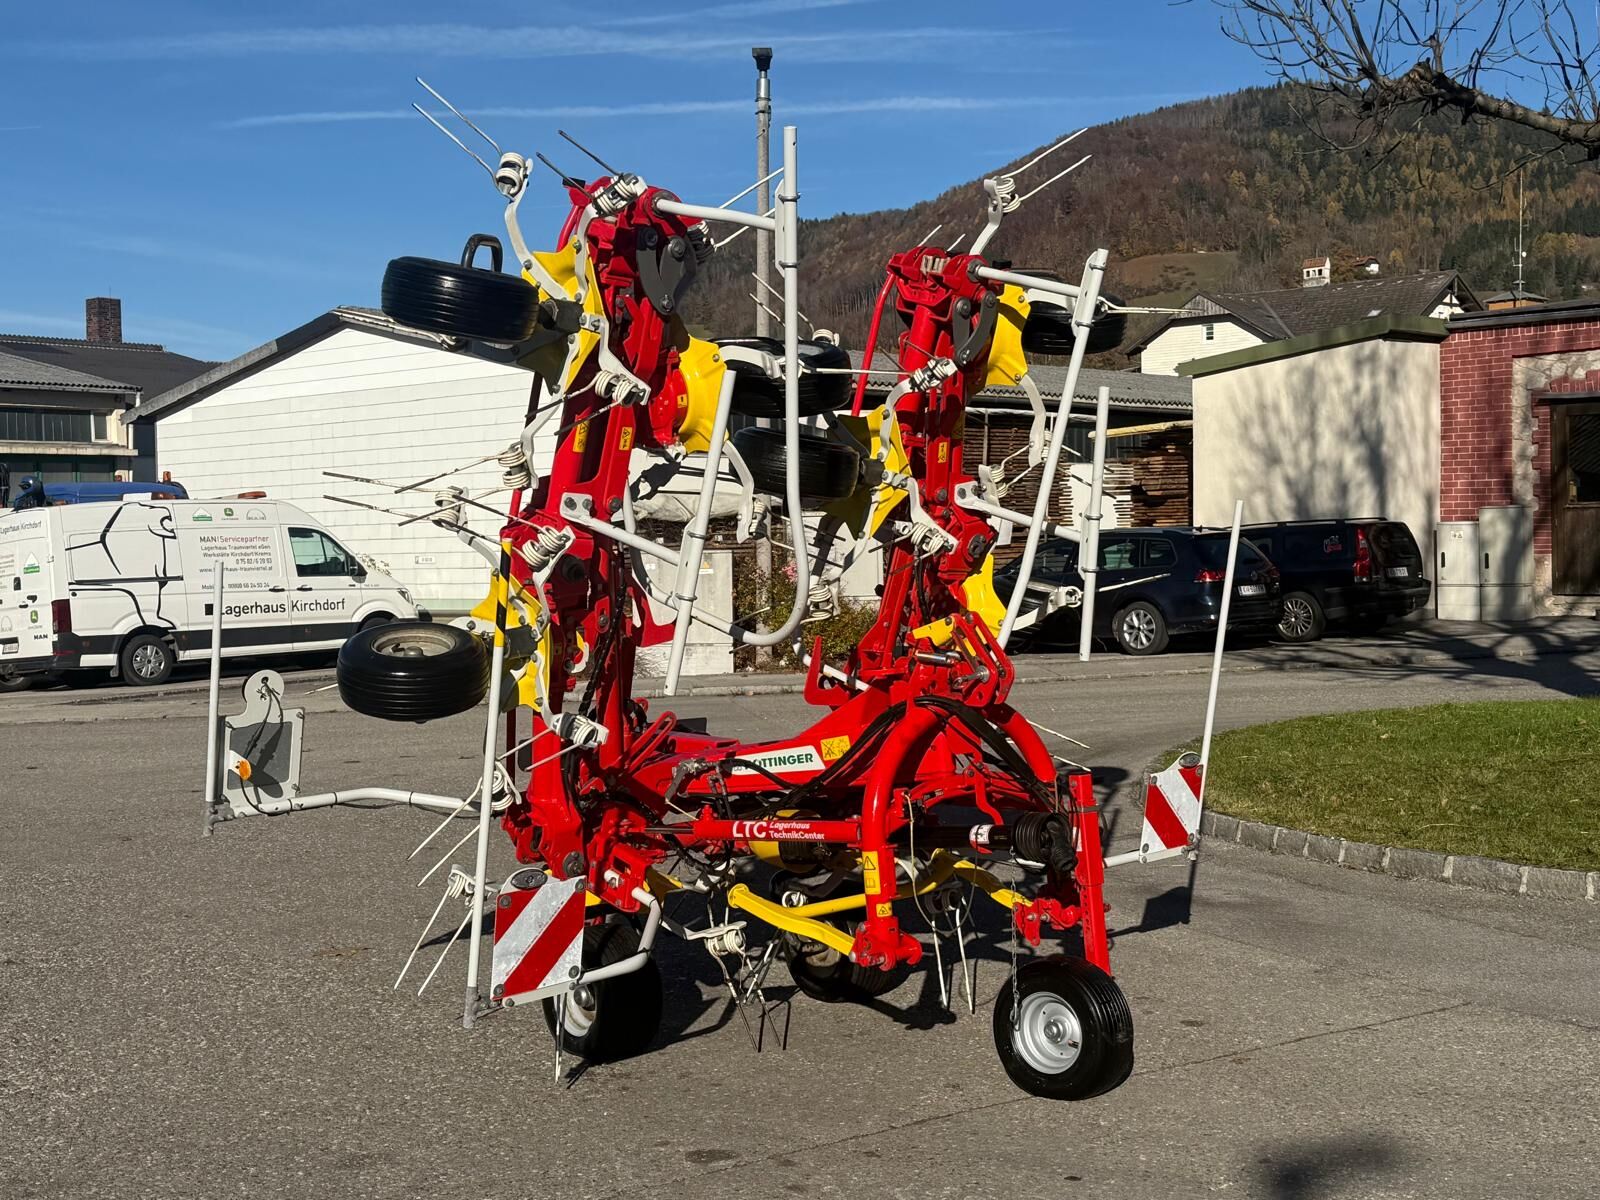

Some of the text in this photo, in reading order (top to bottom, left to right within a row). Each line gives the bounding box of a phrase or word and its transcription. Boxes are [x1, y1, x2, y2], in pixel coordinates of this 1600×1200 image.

[291, 598, 346, 612] Kirchdorf
[732, 820, 810, 839] LTC Lagerhaus
[769, 830, 825, 840] TechnikCenter
